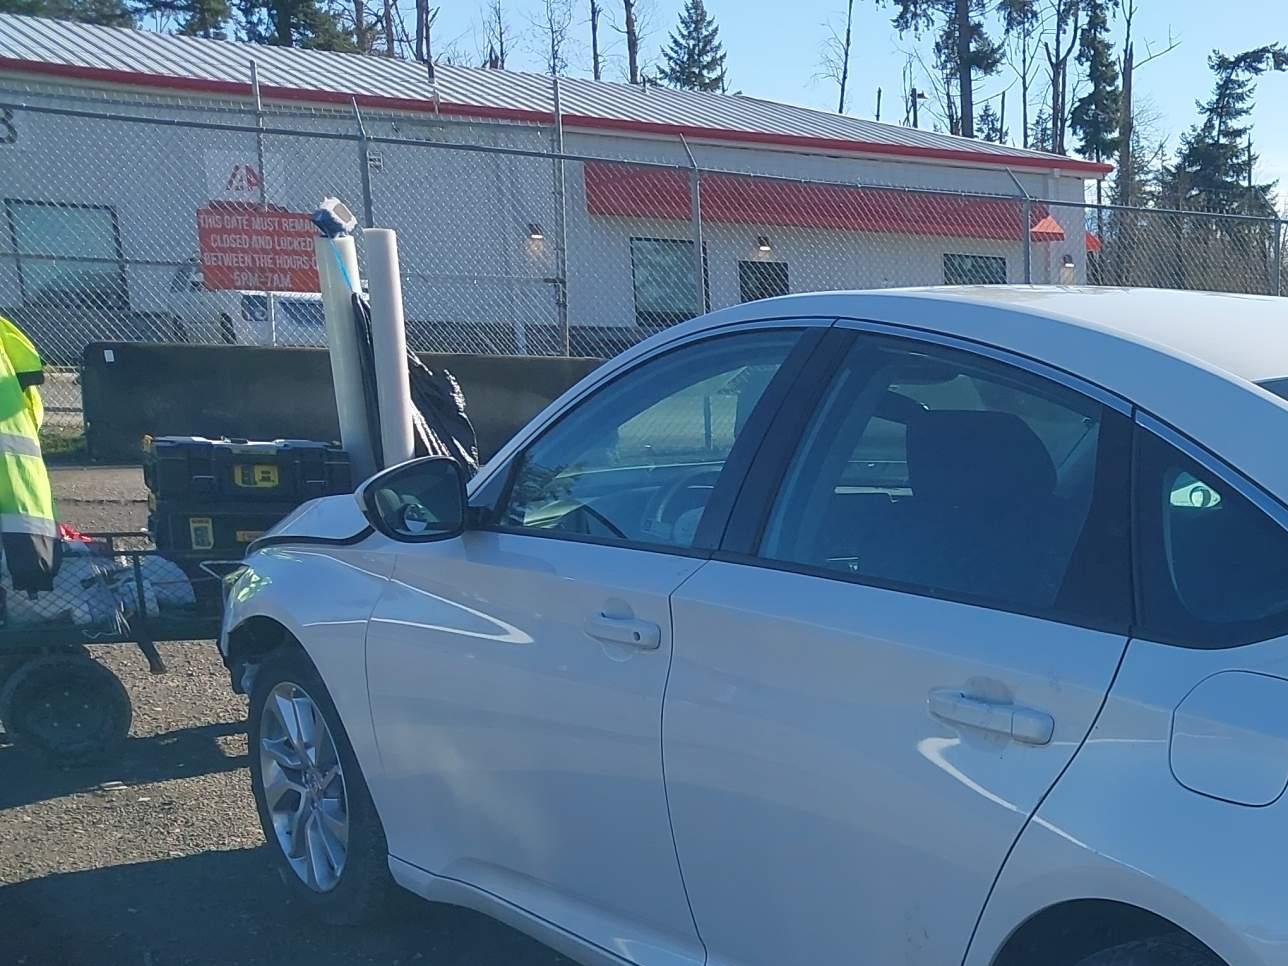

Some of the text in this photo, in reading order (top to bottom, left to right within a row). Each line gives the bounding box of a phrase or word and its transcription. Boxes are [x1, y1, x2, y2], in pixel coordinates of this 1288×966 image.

[201, 215, 222, 229] THIS
[224, 215, 250, 230] GATE
[252, 217, 280, 232] MUST
[210, 233, 314, 251] CLOSED AND LOCKED
[204, 252, 253, 267] BETWEEN
[254, 254, 274, 267] THE
[275, 255, 310, 269] HOURS
